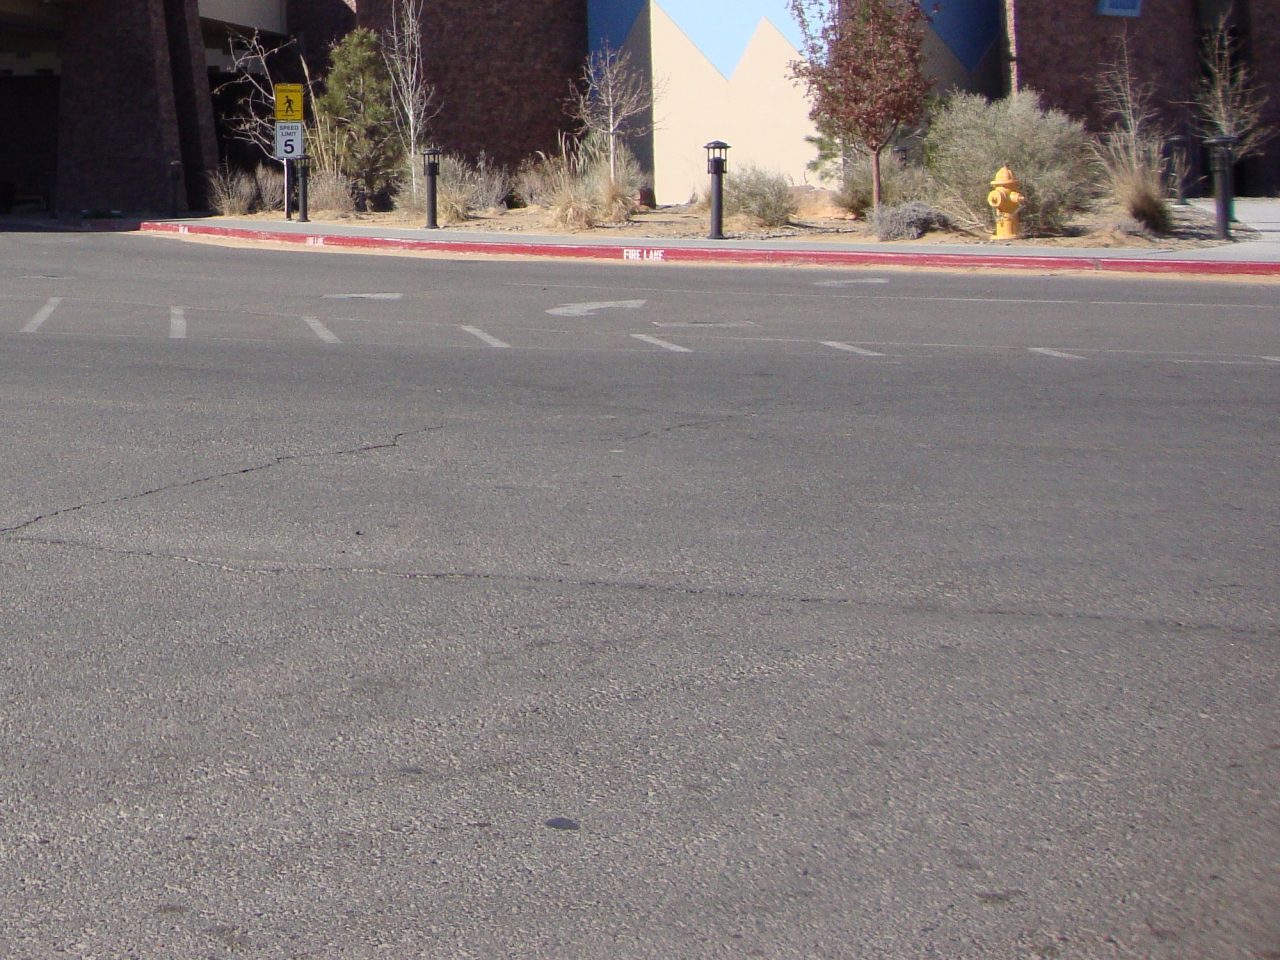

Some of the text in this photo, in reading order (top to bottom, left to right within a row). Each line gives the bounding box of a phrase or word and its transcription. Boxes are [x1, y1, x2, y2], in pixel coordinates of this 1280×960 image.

[283, 139, 295, 154] 5
[623, 249, 665, 261] FIRE LANE
